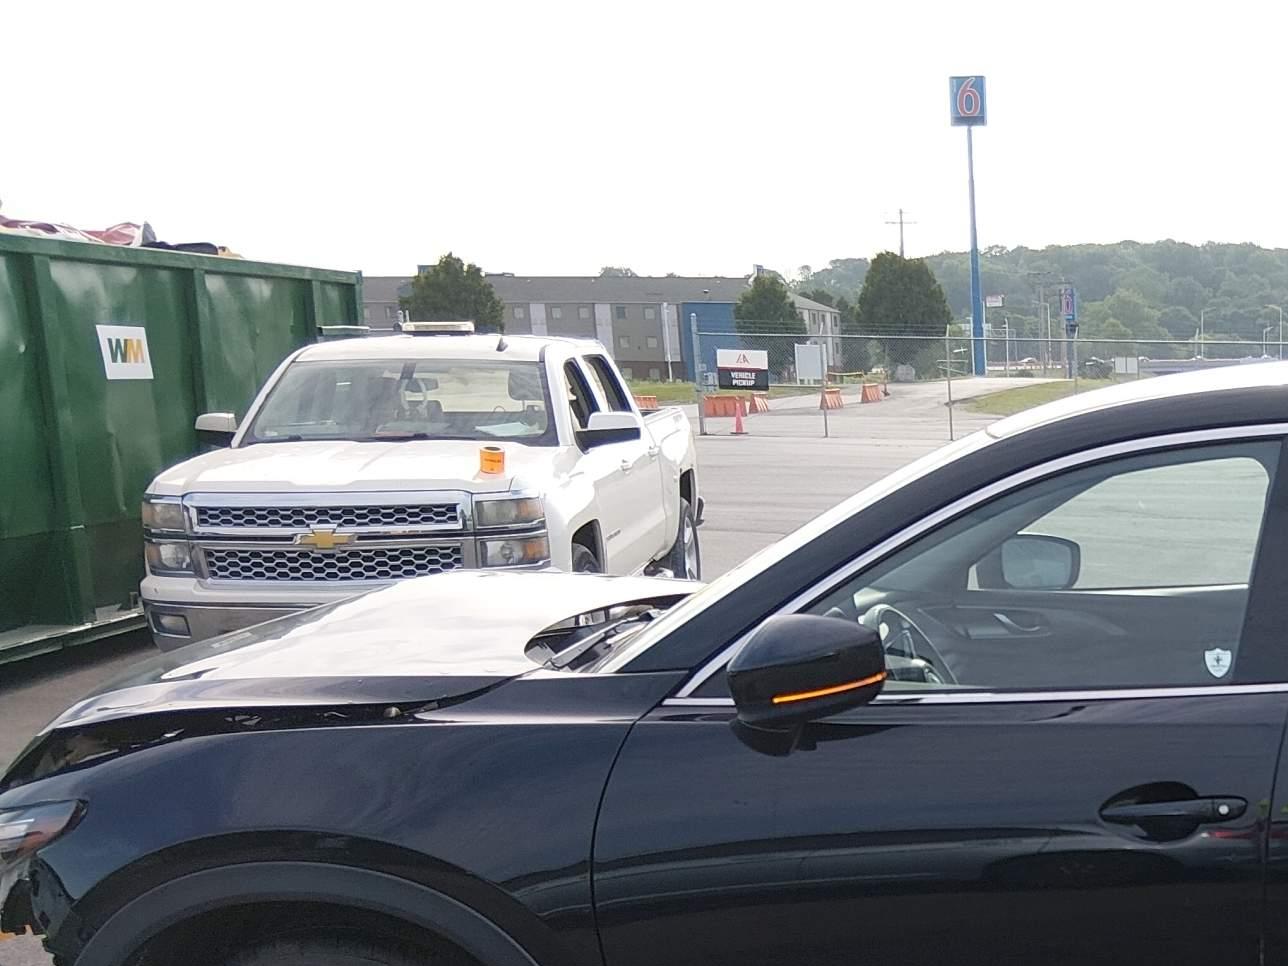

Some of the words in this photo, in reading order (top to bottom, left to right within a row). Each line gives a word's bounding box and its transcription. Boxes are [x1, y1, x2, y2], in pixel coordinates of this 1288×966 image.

[957, 77, 980, 117] 6
[107, 338, 145, 363] WM
[730, 371, 756, 380] VEHICLE
[732, 379, 755, 387] PICKUP
